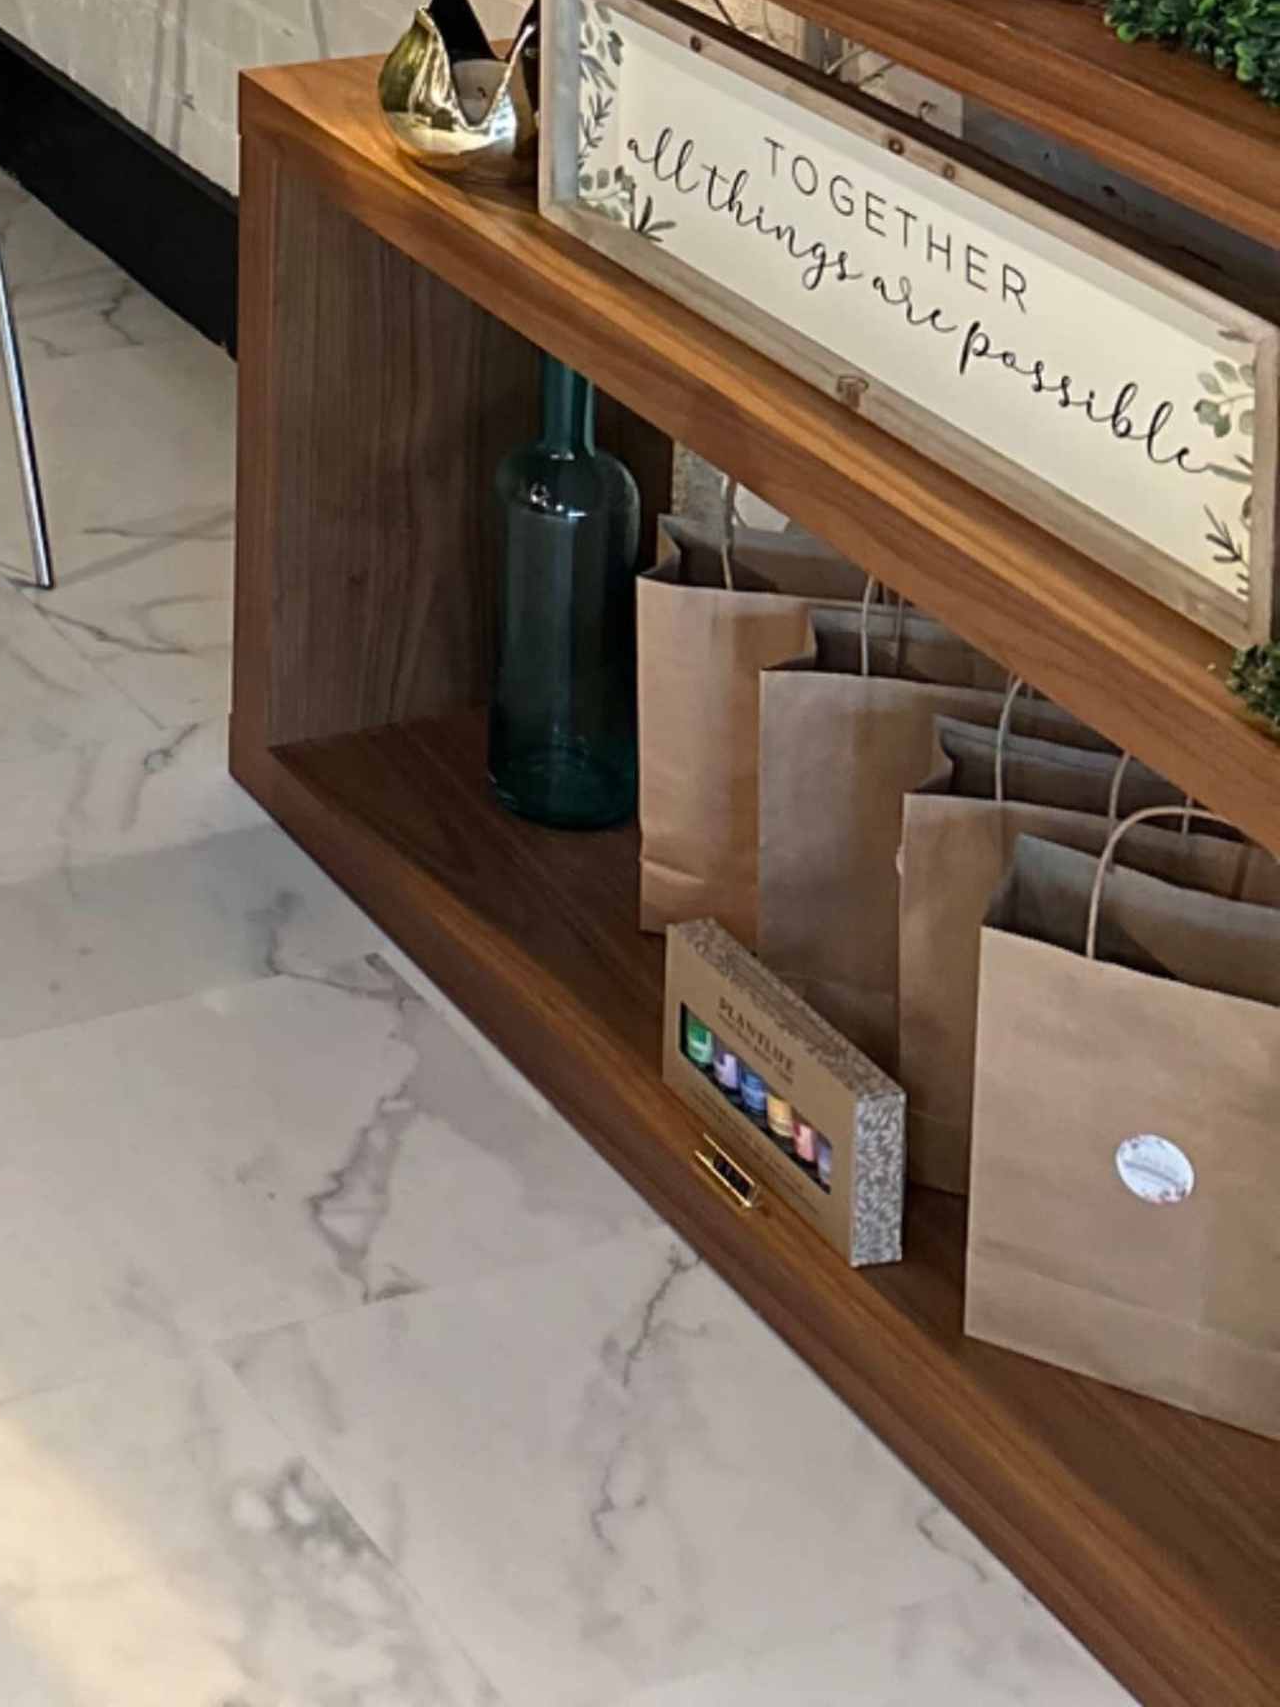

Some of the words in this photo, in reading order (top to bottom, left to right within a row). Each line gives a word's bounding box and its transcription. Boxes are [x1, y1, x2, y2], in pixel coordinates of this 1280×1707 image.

[626, 126, 701, 194] all
[700, 162, 864, 291] things
[872, 275, 958, 332] are
[958, 320, 1214, 473] possible
[763, 135, 1028, 314] TOGETHER
